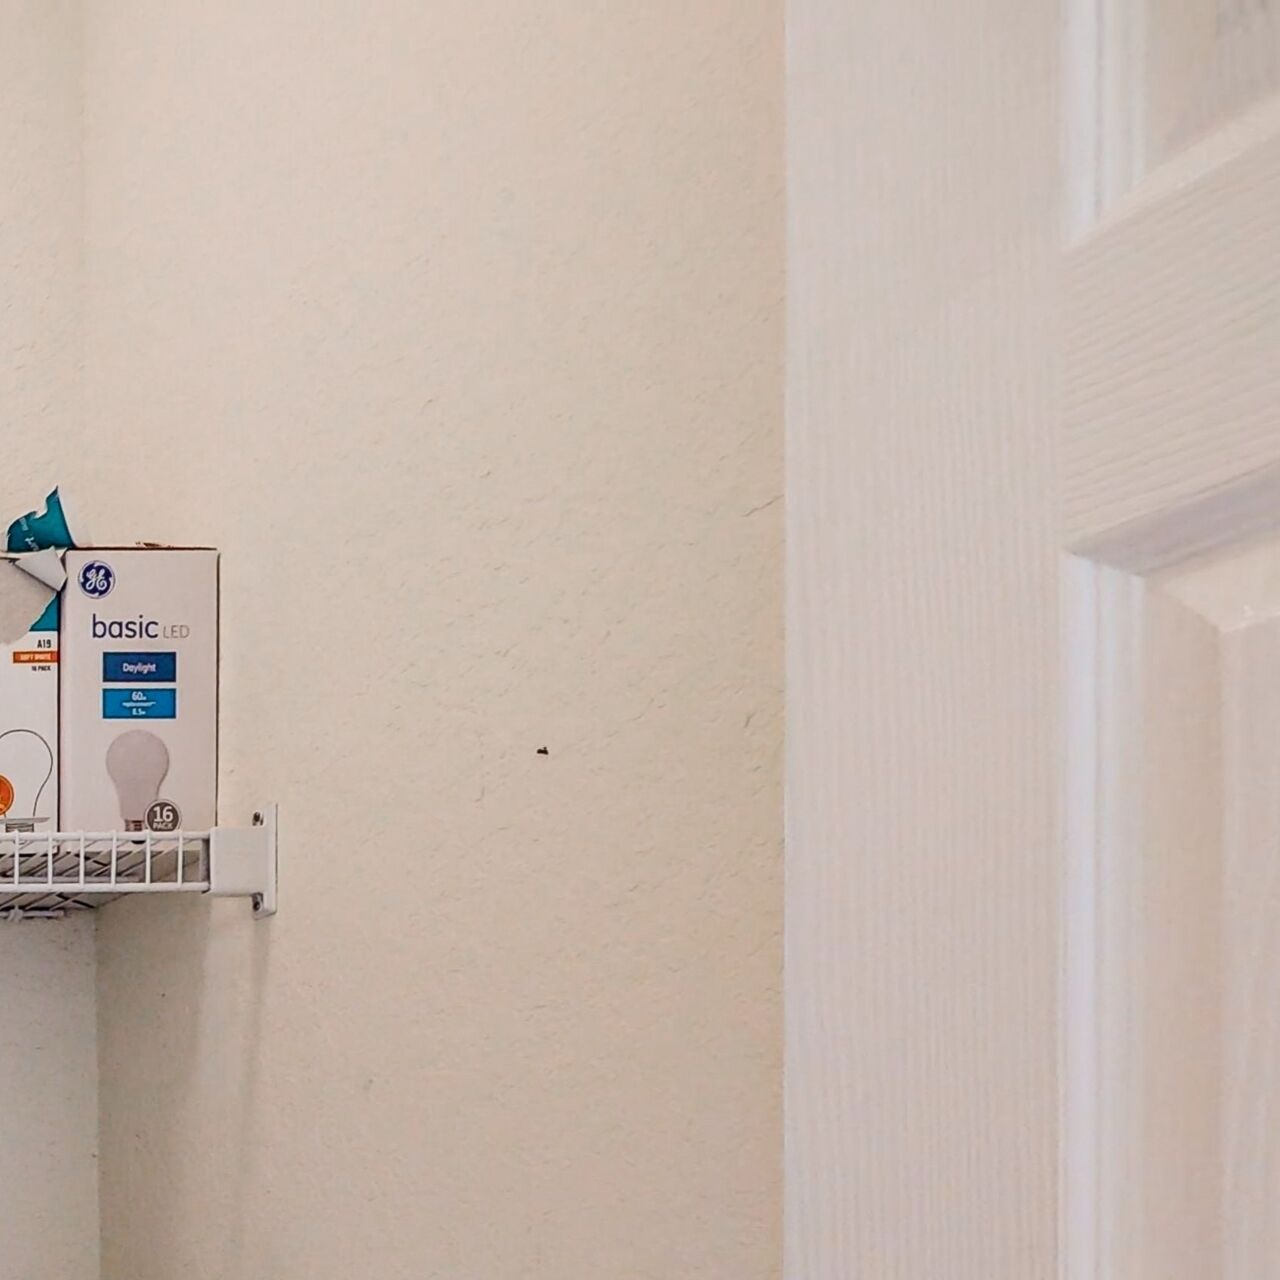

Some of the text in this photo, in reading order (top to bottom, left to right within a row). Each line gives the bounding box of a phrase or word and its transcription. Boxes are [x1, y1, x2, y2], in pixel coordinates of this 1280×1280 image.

[92, 613, 190, 639] basic LED
[37, 639, 51, 648] A19
[122, 662, 156, 674] Daylight
[153, 806, 174, 822] 16
[153, 822, 173, 830] PACK
